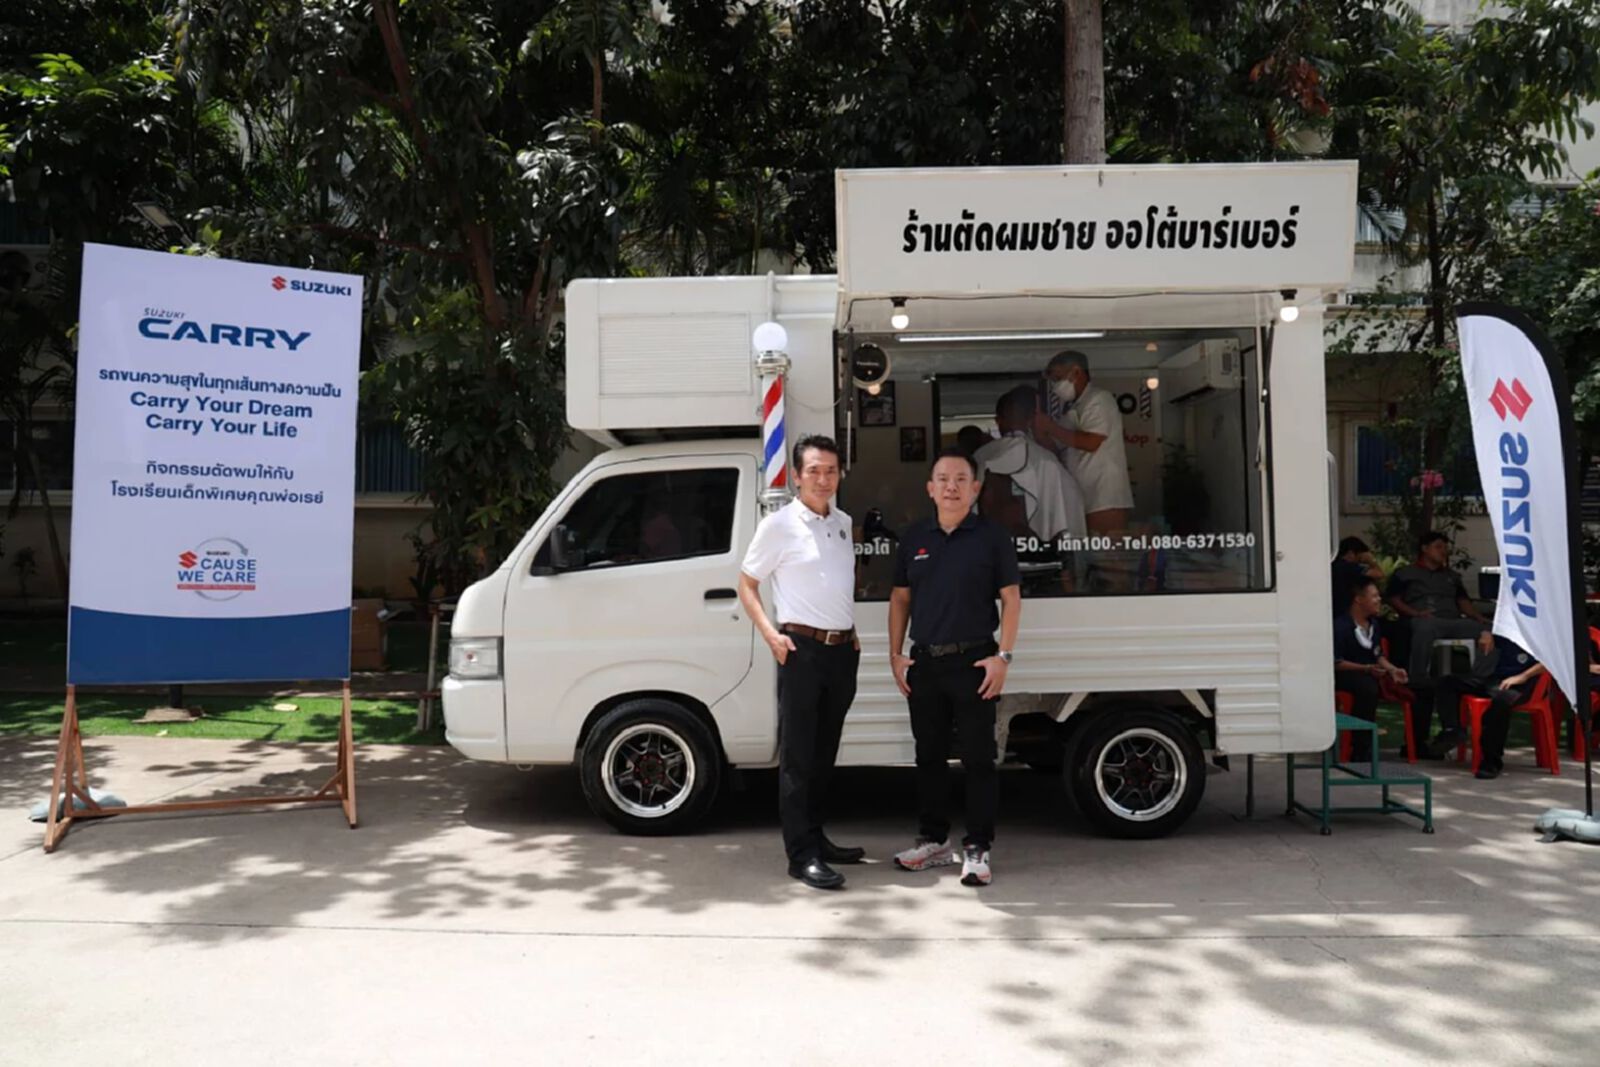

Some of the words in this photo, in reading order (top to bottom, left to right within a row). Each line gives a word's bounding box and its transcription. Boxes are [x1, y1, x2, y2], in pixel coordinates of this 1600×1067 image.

[903, 209, 1096, 253] ร้านตัดผมชาย
[1106, 205, 1299, 249] ออโต้บาร์เบอร์
[291, 280, 351, 296] SUZUKI
[143, 307, 186, 319] SUZUKI
[137, 318, 311, 351] CARRY
[130, 391, 190, 413] Carry
[196, 396, 243, 413] Your
[249, 400, 312, 418] Dream
[145, 413, 203, 436] Carry
[211, 418, 256, 434] Your
[263, 421, 297, 437] Life
[146, 460, 294, 481] กิจกรรมตัดผมให้กับ
[1011, 536, 1051, 553] 50.-
[201, 558, 256, 570] CAUSE
[178, 570, 205, 583] WE
[212, 571, 256, 583] CARE
